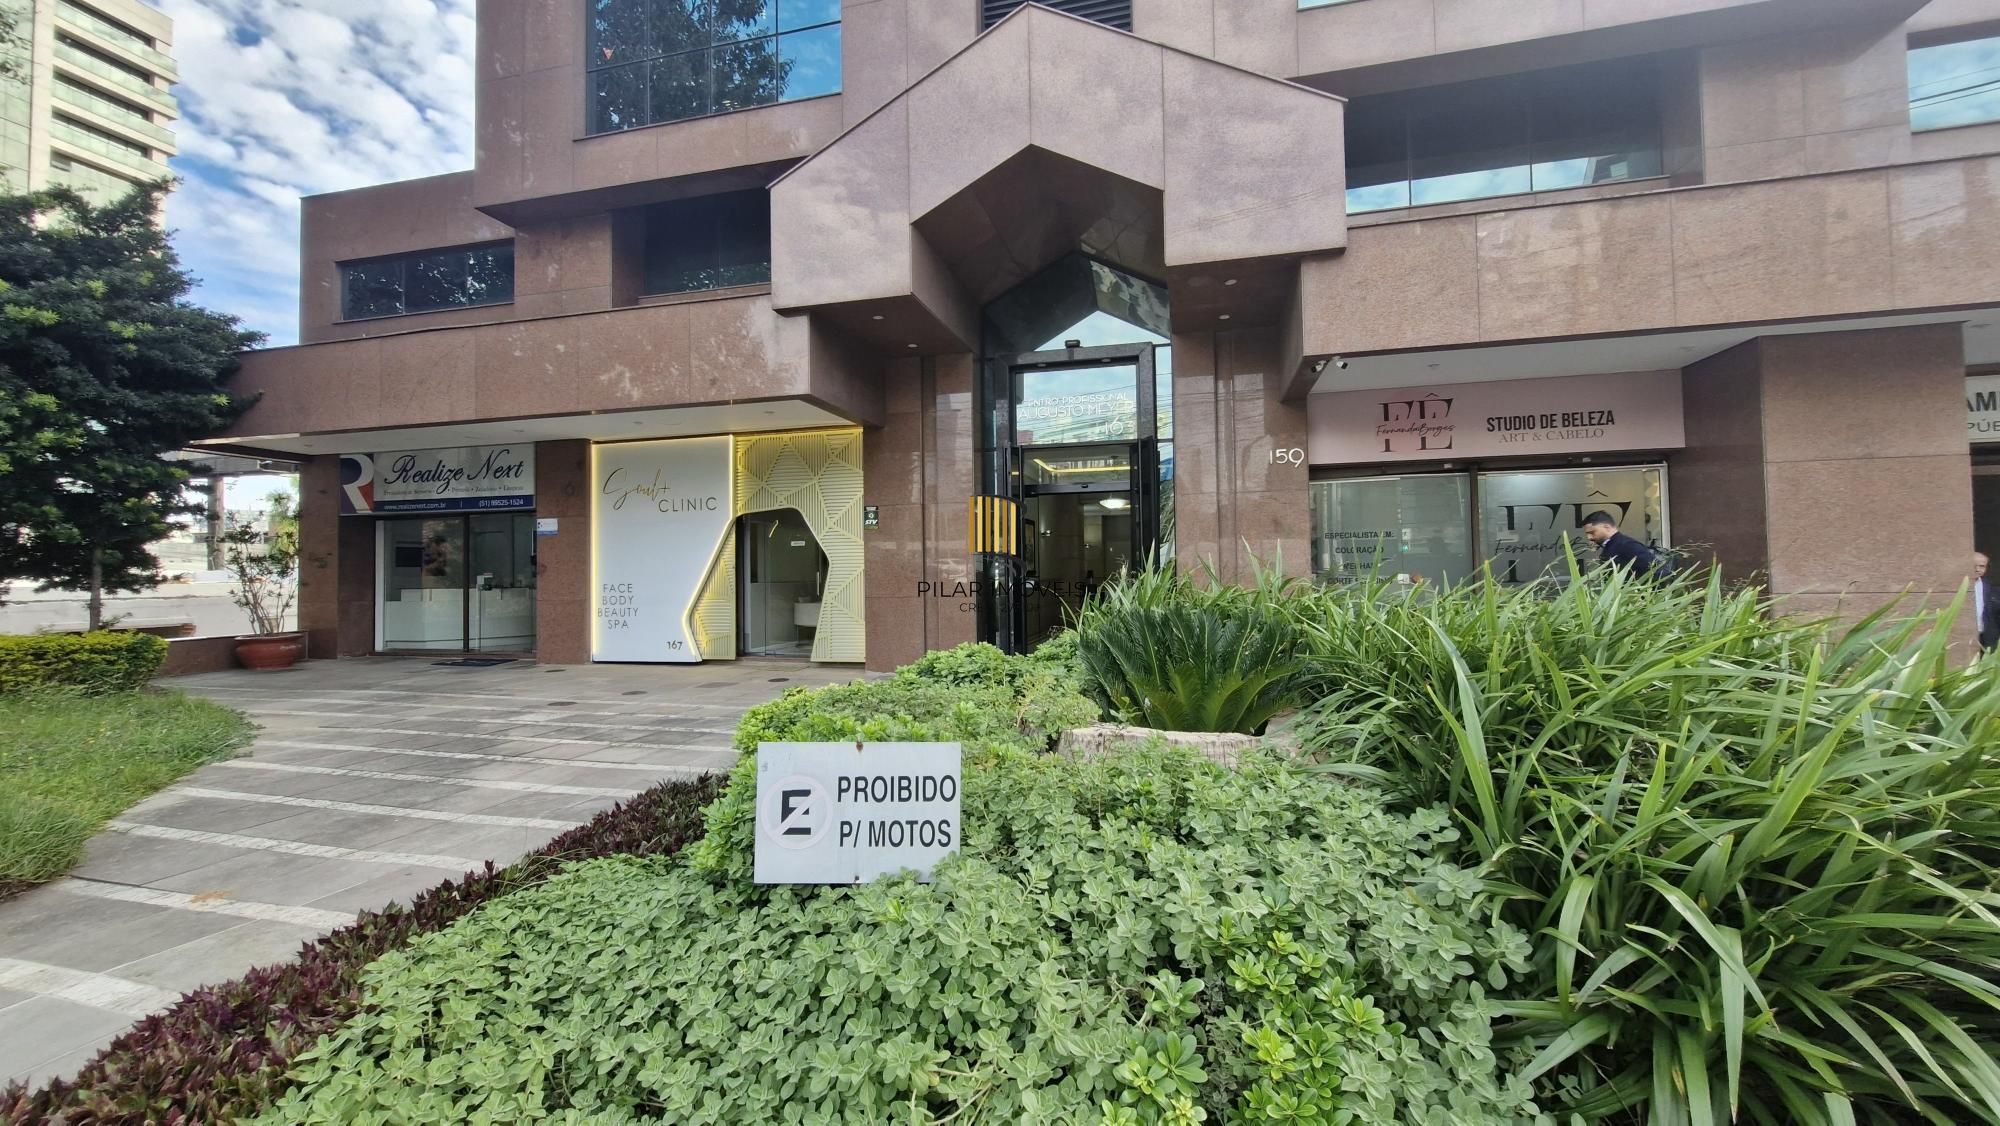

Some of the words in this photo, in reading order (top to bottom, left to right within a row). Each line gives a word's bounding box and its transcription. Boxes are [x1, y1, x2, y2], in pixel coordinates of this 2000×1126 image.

[1020, 397, 1058, 408] NTRO
[1018, 405, 1084, 419] AUGUSTO
[1487, 415, 1536, 432] STUDIO
[1540, 413, 1558, 429] DE
[1562, 410, 1615, 427] BELEZA
[1376, 422, 1420, 437] Fernanda
[1499, 432, 1529, 443] ART
[1533, 432, 1542, 441] &
[1546, 428, 1605, 440] CABELO
[1269, 448, 1305, 468] 159
[384, 454, 465, 494] Realize
[467, 449, 524, 480] Next
[658, 496, 718, 513] CLINIC
[1325, 531, 1379, 539] ESPECIALISTA
[603, 583, 633, 593] FACE
[602, 595, 634, 605] BODY
[597, 607, 639, 617] BEAUTY
[607, 619, 629, 629] SPA
[667, 640, 683, 650] 167
[837, 775, 957, 803] PROIBIDO
[839, 820, 861, 848] P/
[868, 819, 951, 847] MOTOS
